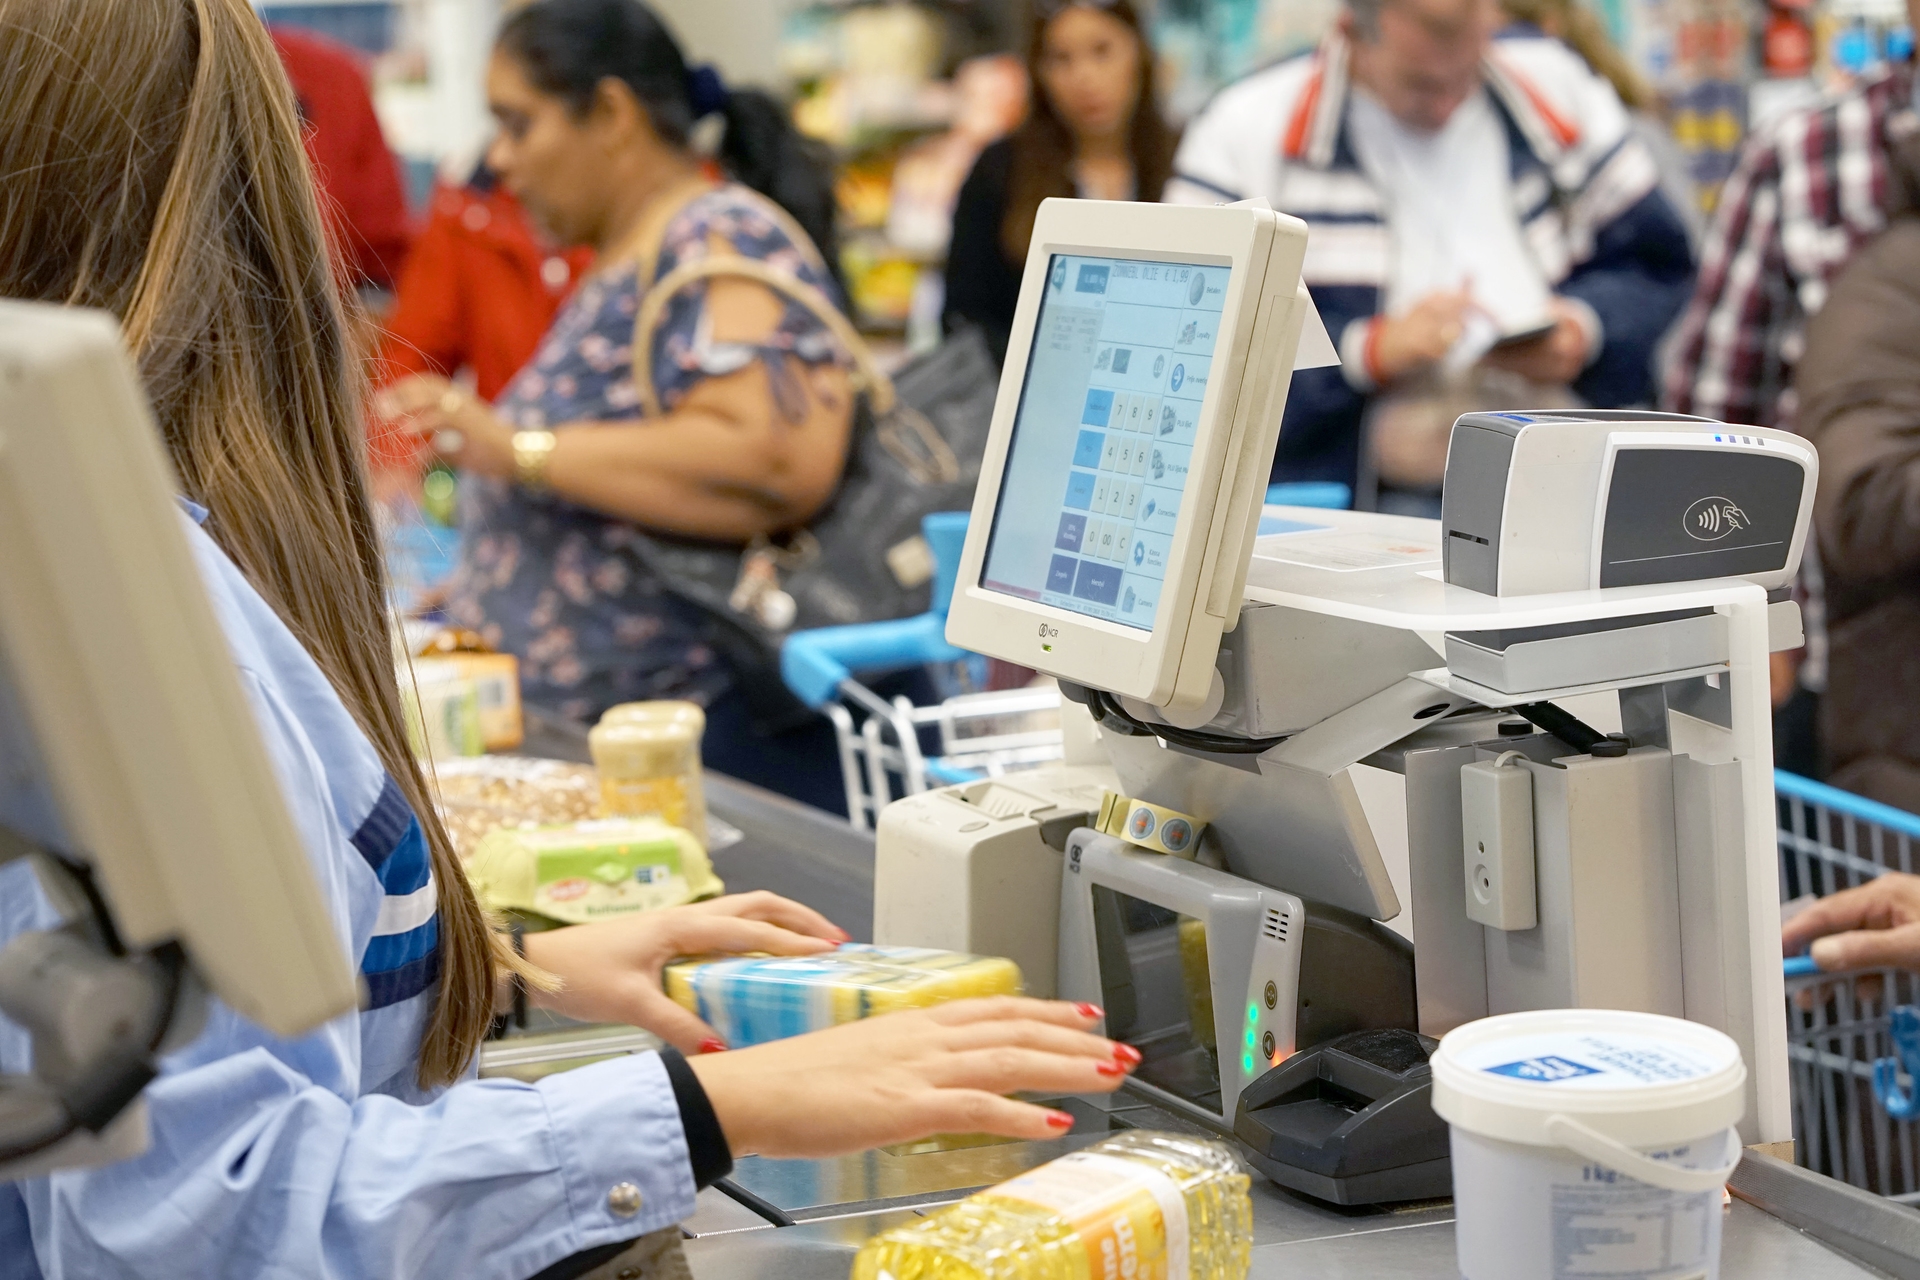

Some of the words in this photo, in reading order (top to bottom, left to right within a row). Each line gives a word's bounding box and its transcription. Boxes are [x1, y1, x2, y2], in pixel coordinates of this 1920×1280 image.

[1142, 267, 1159, 280] OLIE
[1165, 269, 1170, 281] €
[1173, 269, 1190, 284] 1,99
[1206, 286, 1221, 295] Betalen
[1197, 331, 1210, 340] Loyalty
[1117, 404, 1123, 416] 7
[1132, 407, 1138, 418] 8
[1147, 409, 1153, 421] 9
[1108, 447, 1113, 458] 4
[1123, 449, 1128, 460] 5
[1138, 451, 1144, 463] 6
[1098, 488, 1103, 500] 1
[1113, 491, 1119, 503] 2
[1129, 494, 1135, 506] 3
[1089, 531, 1095, 542] 0
[1102, 534, 1112, 546] 00
[1120, 537, 1125, 549] C
[1138, 598, 1152, 608] Camera
[1048, 628, 1058, 638] NCR
